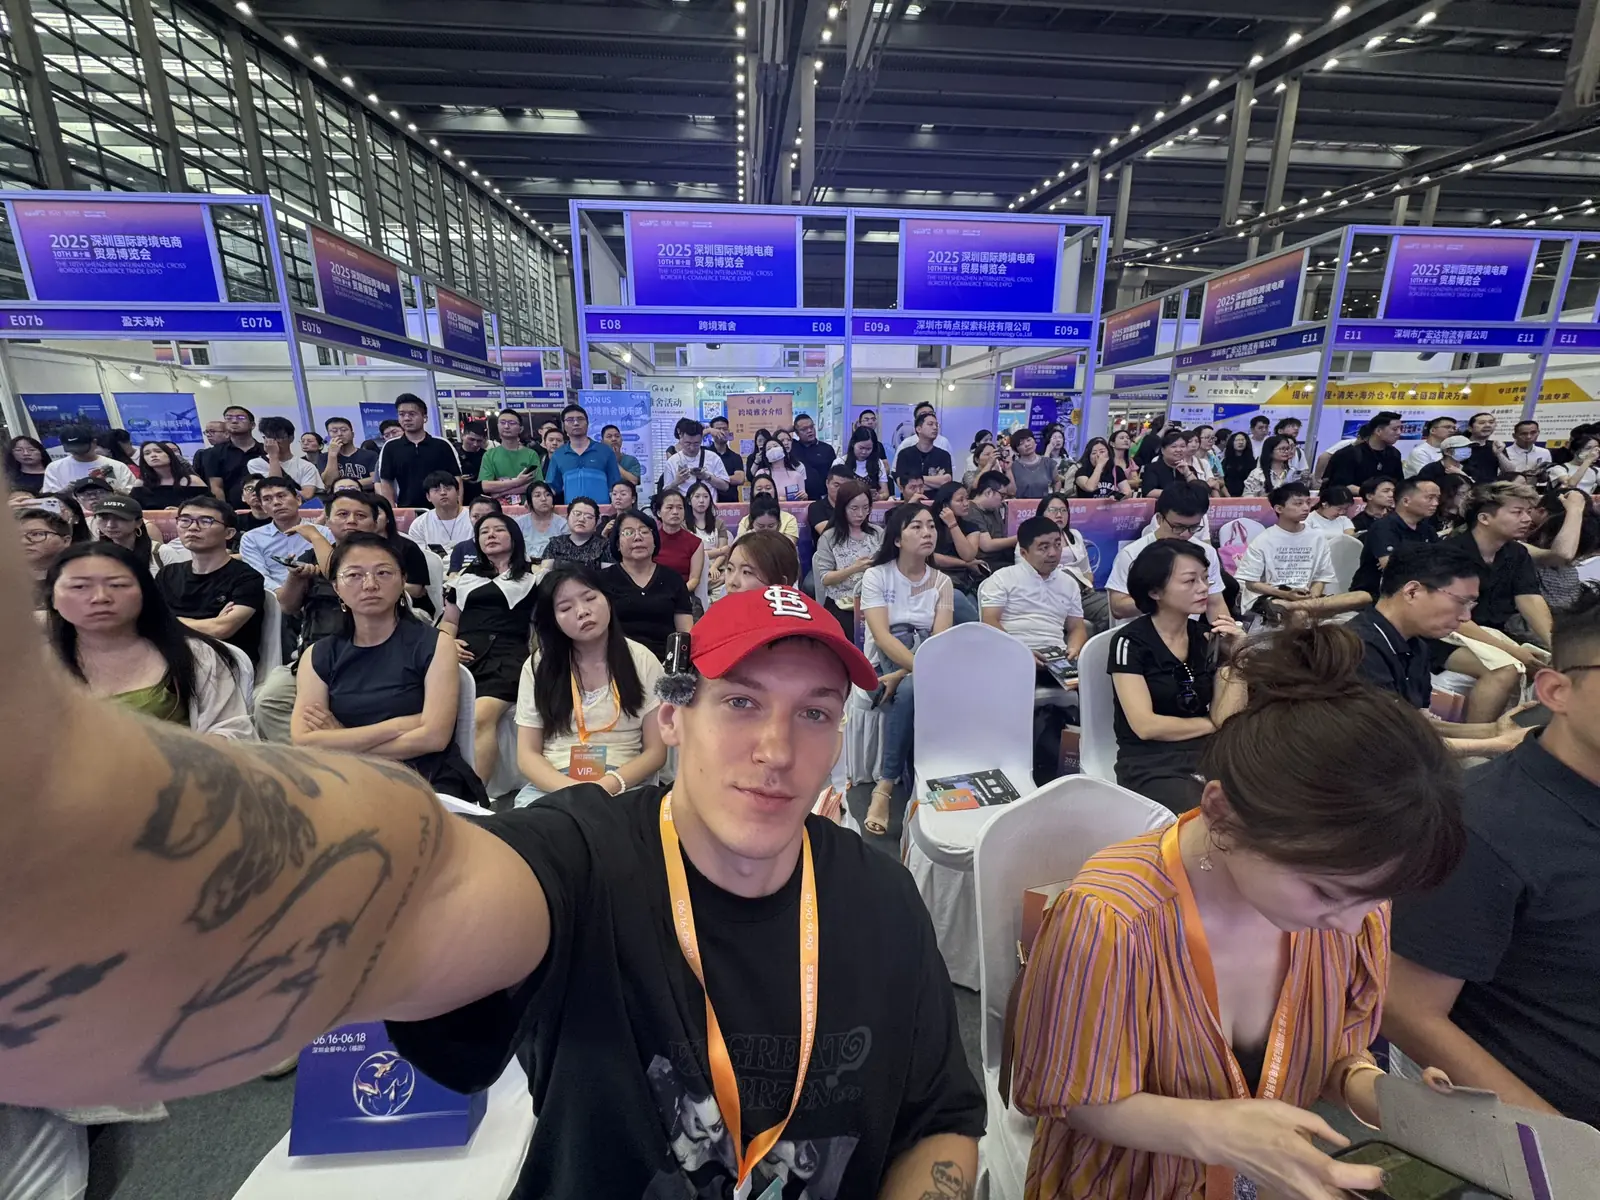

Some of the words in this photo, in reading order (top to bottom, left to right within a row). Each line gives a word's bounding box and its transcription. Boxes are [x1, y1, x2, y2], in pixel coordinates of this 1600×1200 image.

[49, 234, 89, 249] 2025
[90, 234, 182, 249] 深圳国际跨境电商
[94, 248, 152, 260] 贸易博览会
[657, 243, 692, 257] 2025
[694, 244, 774, 257] 深圳国际跨境电商
[694, 256, 744, 268] 贸易博览会
[927, 250, 959, 264] 2025
[961, 251, 1035, 264] 深圳国际跨境电商
[330, 261, 351, 279] 2025
[961, 263, 1007, 275] 贸易博览会
[1411, 263, 1441, 276] 2025
[1441, 264, 1508, 276] 深圳国际跨境电商
[1439, 275, 1481, 286] 贸易博览会
[1216, 294, 1236, 309] 2025
[10, 315, 43, 326] E07b
[121, 316, 165, 328] 盈天海外
[240, 317, 272, 329] E07b
[600, 319, 621, 330] E08
[916, 320, 1031, 333] 深圳市萌点探索科技有限公司
[301, 320, 322, 335] E07b
[812, 322, 832, 333] E08
[864, 322, 890, 333] E09a
[1054, 325, 1079, 337] E09a
[1302, 332, 1318, 344] E11
[1344, 331, 1361, 340] E11
[1393, 329, 1488, 341] 深圳市广宏达物流有限公司
[1517, 333, 1534, 343] E11
[1560, 334, 1577, 344] E11
[410, 349, 423, 360] E07b
[1182, 357, 1193, 365] E11
[585, 396, 600, 404] JOIN
[601, 396, 611, 404] US
[104, 501, 126, 509] LUSTY
[1017, 509, 1037, 519] 2025
[577, 767, 593, 776] VIP
[313, 1032, 365, 1044] 06/16-06/18
